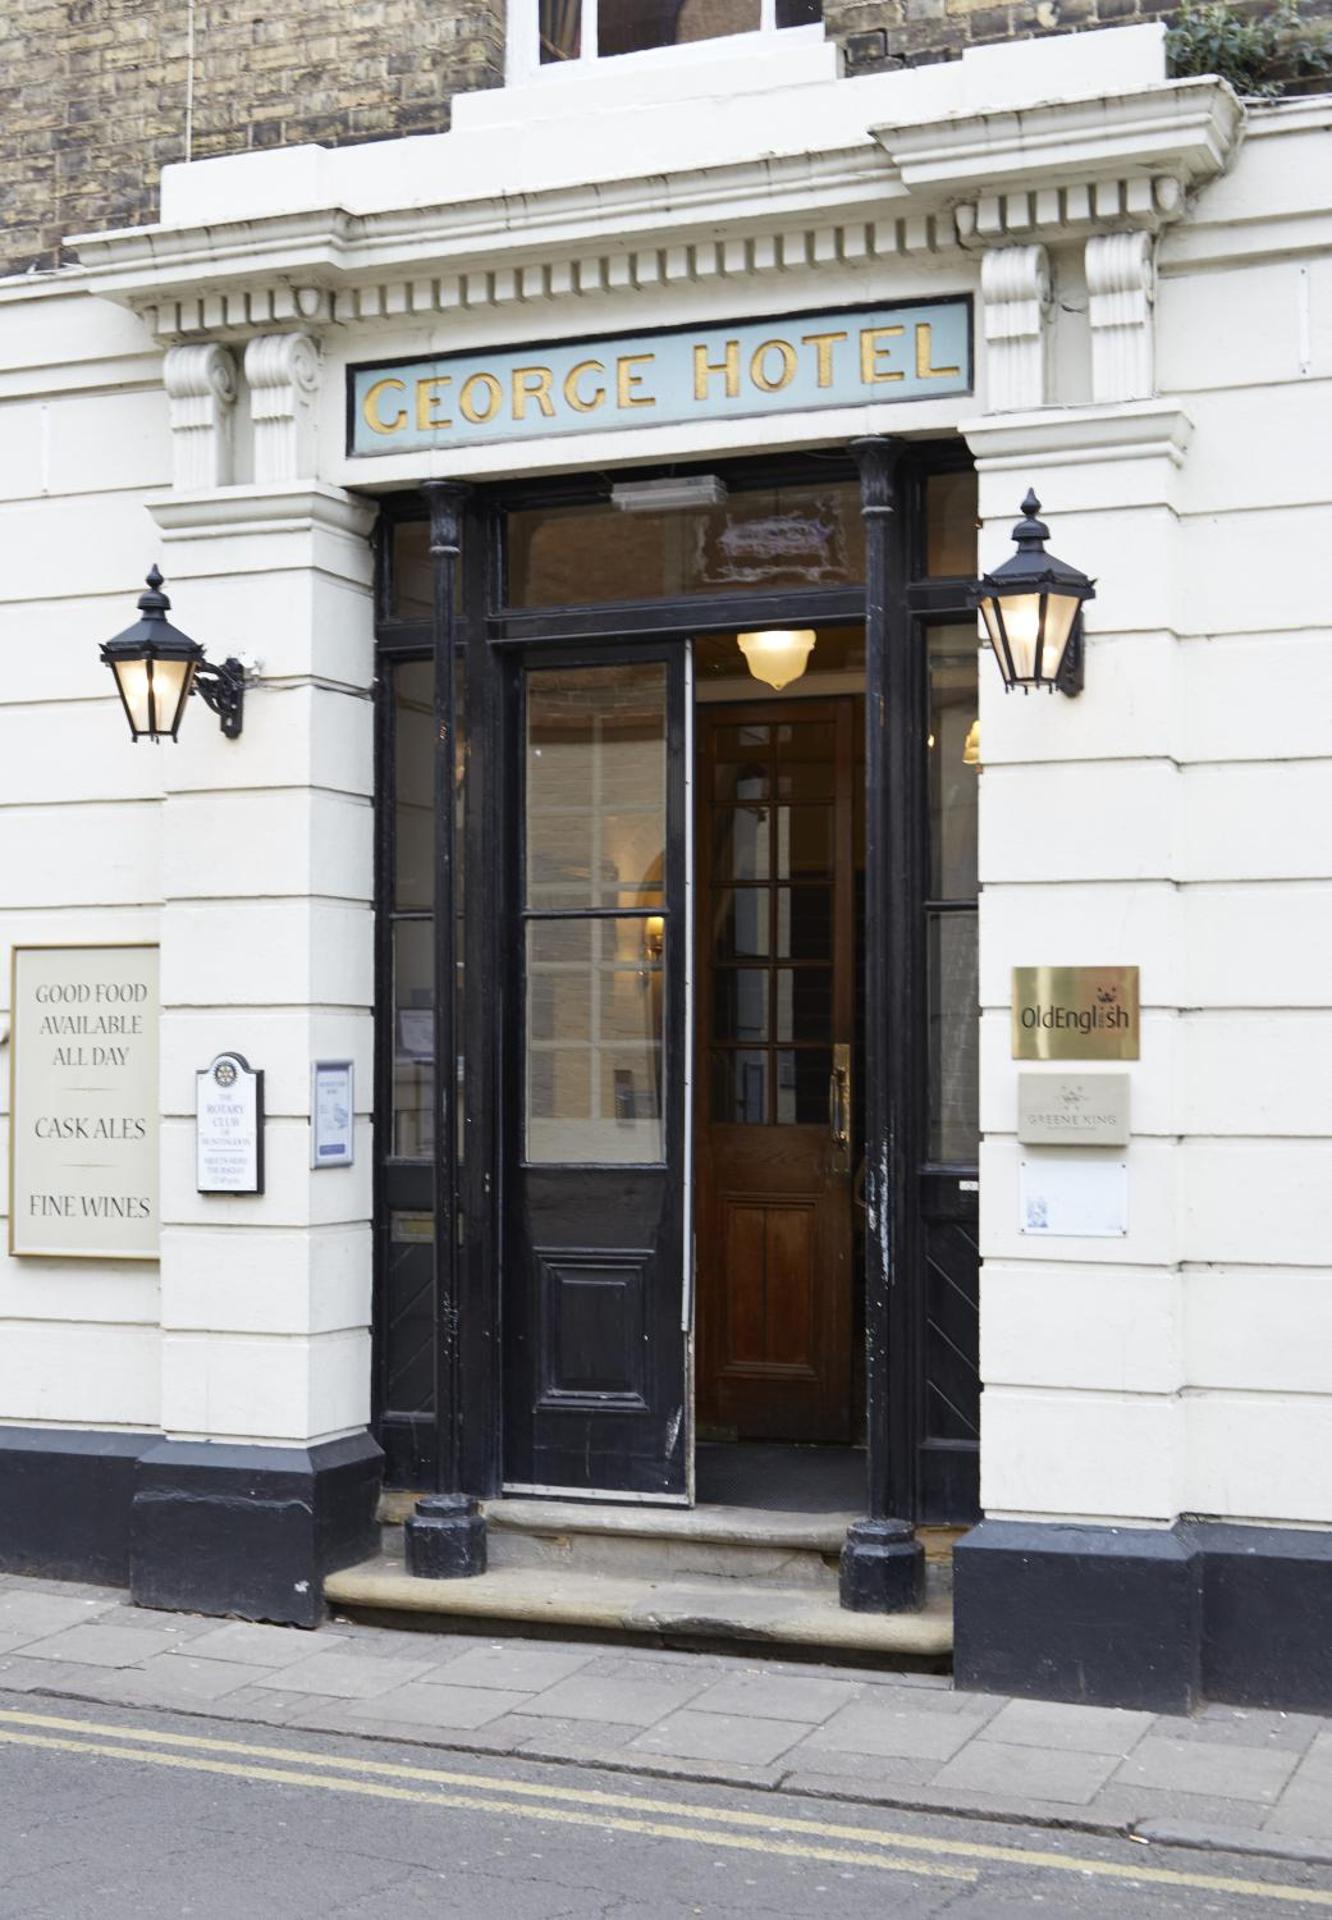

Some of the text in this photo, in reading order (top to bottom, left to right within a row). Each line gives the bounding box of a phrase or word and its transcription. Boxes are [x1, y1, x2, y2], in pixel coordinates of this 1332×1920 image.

[363, 323, 960, 435] GEORGE HOTEL
[35, 983, 148, 1003] GOOD FOOD
[39, 1015, 143, 1035] AVAILABLE
[52, 1047, 130, 1066] ALL DAY
[206, 1103, 244, 1114] ROTARY
[35, 1117, 146, 1139] CASK ALES
[1027, 1114, 1117, 1125] GREENE KING
[29, 1194, 150, 1219] FINE WINES
